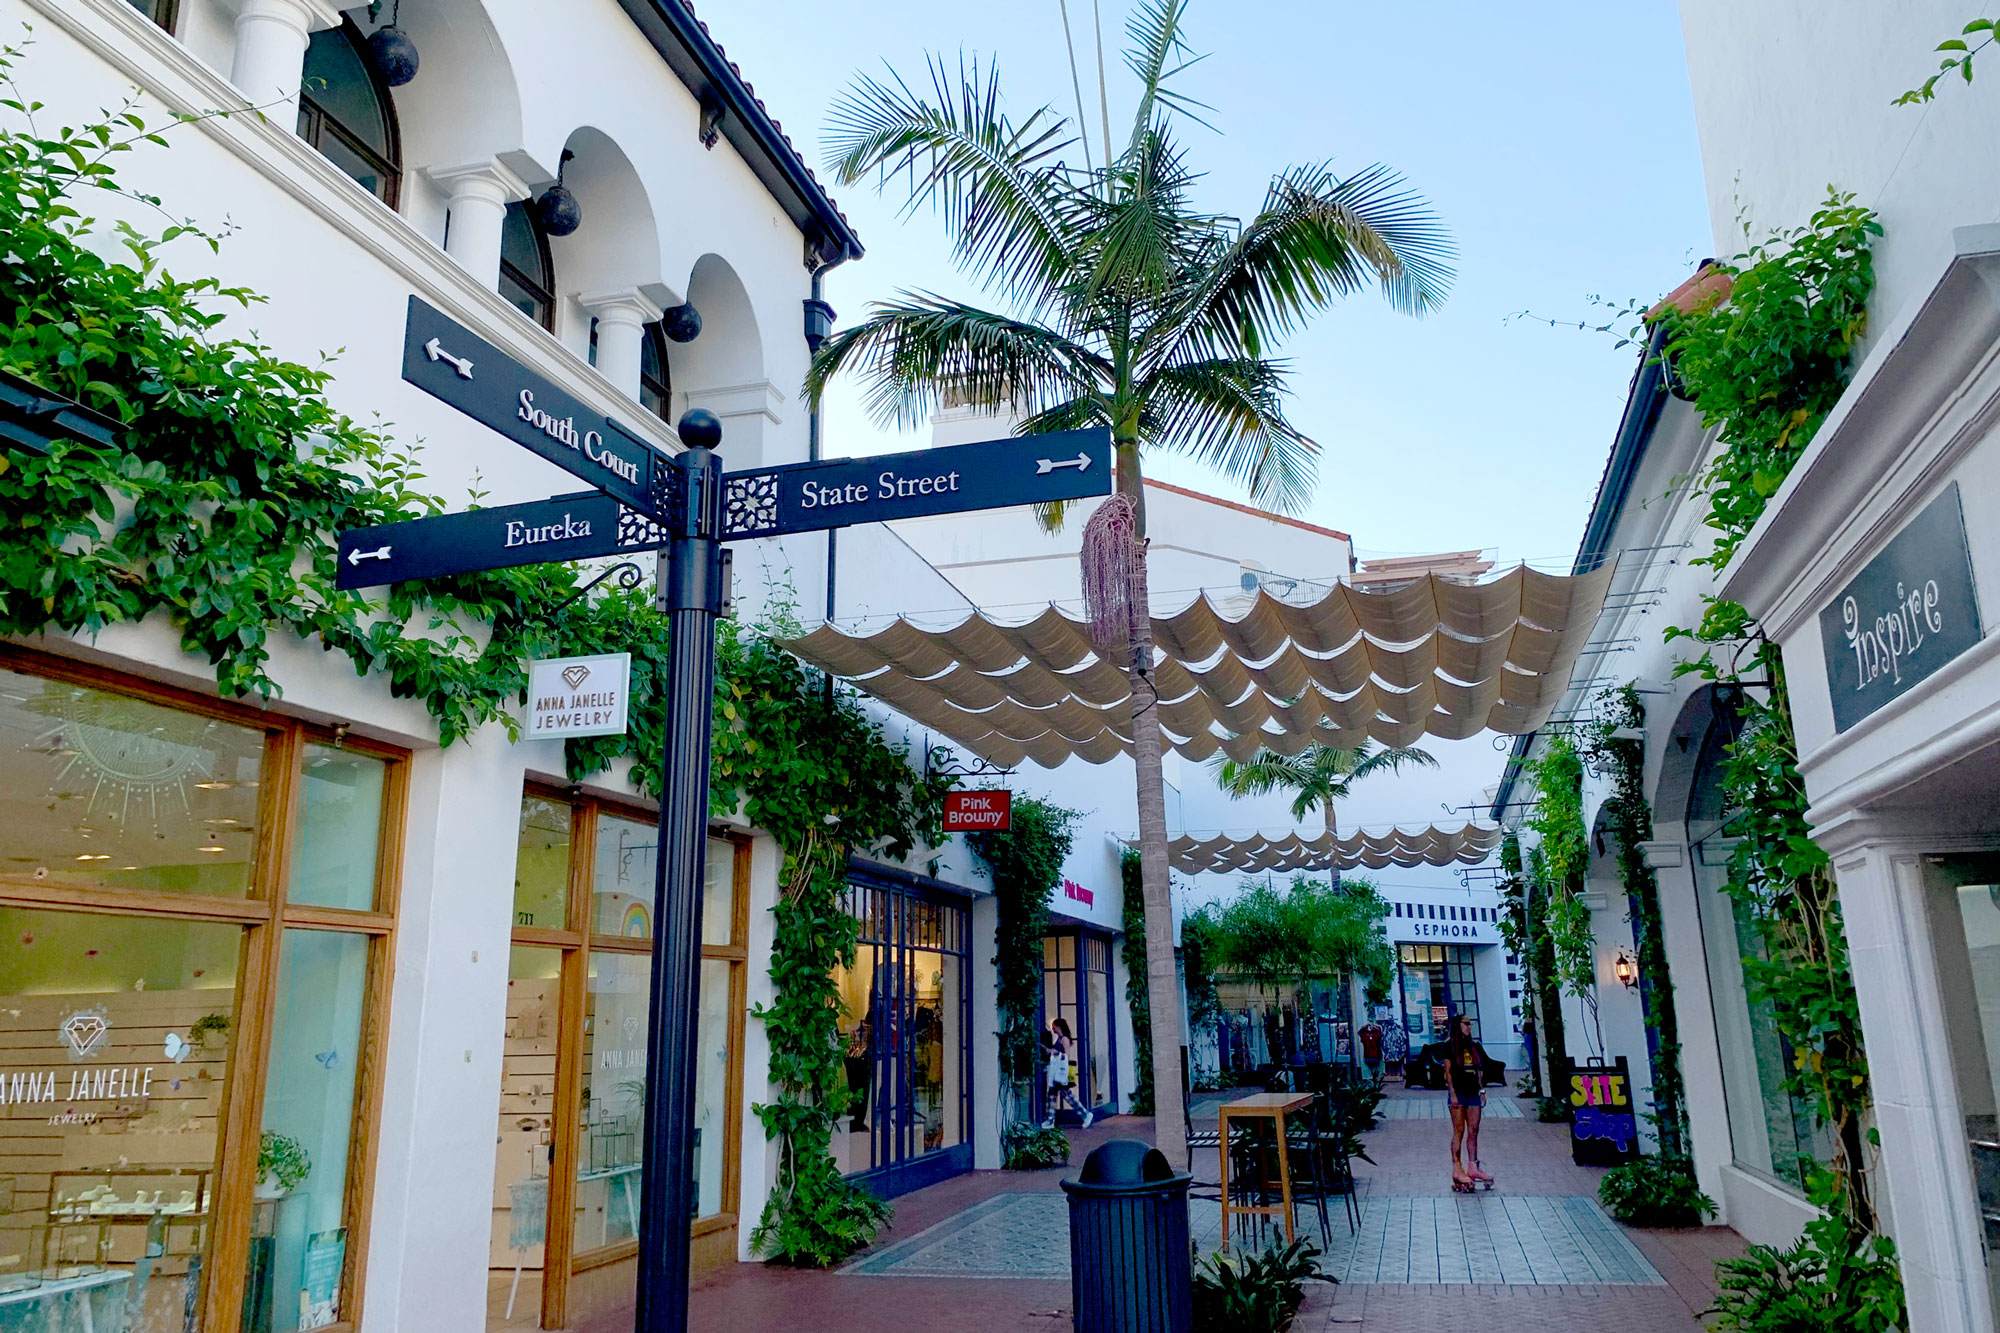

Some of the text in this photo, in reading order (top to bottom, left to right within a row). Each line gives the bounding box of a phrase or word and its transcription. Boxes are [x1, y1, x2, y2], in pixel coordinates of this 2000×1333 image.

[518, 389, 640, 485] South Court
[801, 471, 960, 508] State Street
[504, 513, 592, 547] Eureka
[536, 692, 615, 711] ANNA JANELLE
[536, 710, 613, 729] JEWELRY
[961, 798, 992, 810] Pink
[949, 811, 1004, 826] Browny
[518, 911, 534, 925] 711
[1414, 923, 1478, 937] SEPHORA
[601, 1049, 623, 1070] ANNA
[0, 1067, 154, 1105] ANNA JANELLE
[1570, 1075, 1627, 1107] SKATE
[48, 1112, 97, 1126] JEWELRY
